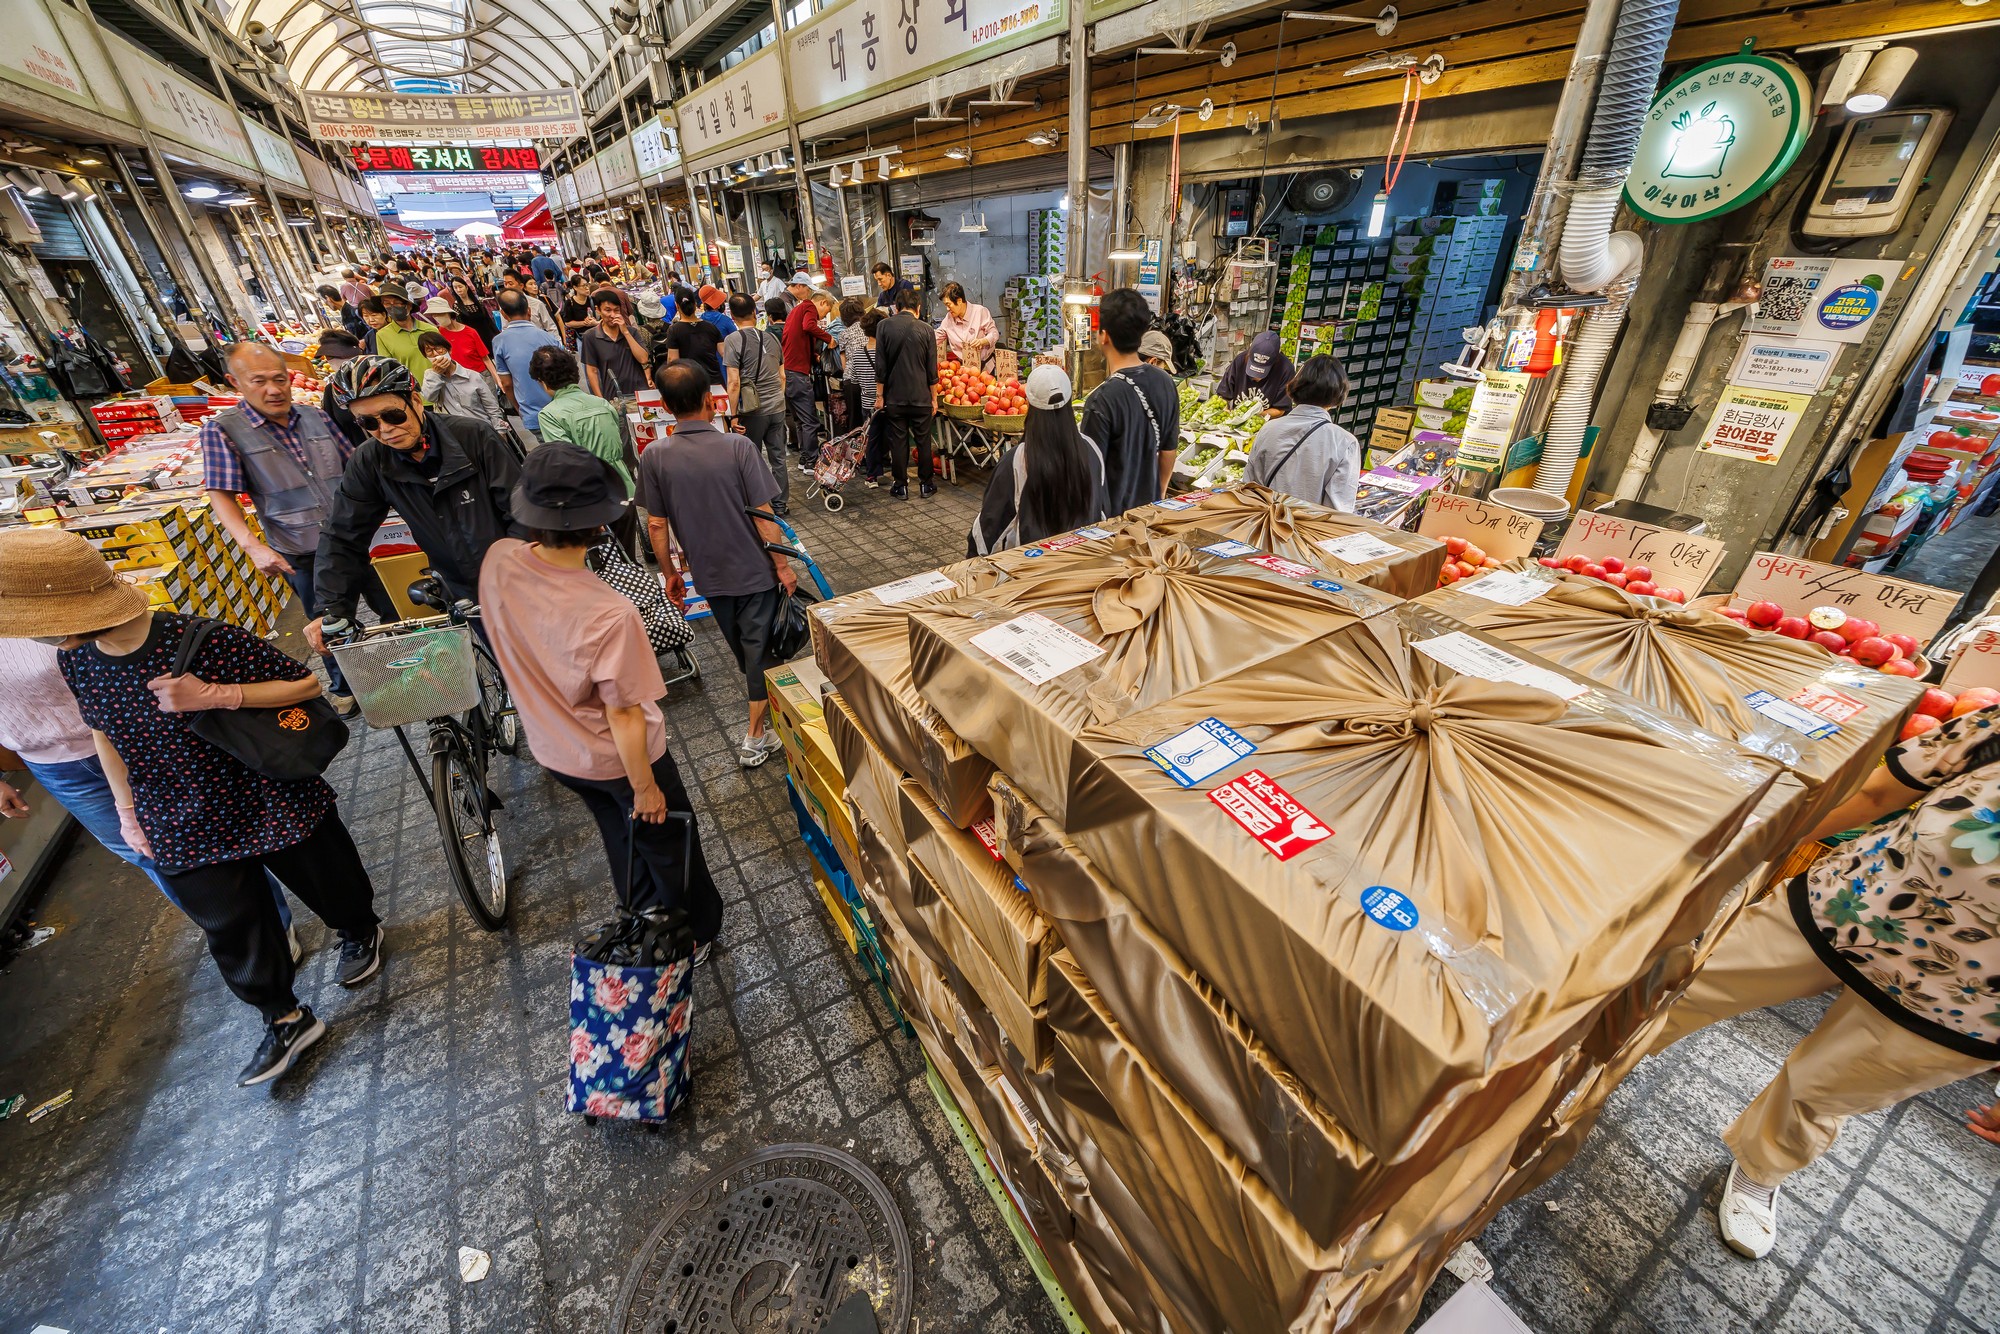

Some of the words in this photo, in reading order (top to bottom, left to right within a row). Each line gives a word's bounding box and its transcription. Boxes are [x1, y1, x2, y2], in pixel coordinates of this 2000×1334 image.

[696, 80, 756, 139] 대일청과
[1771, 259, 1795, 269] 온누리
[1822, 305, 1871, 316] 피해지원금
[1835, 297, 1866, 306] 고유가
[1722, 408, 1786, 431] 환급행사
[1715, 423, 1778, 447] 참여점포
[1201, 718, 1255, 755] 신선식품
[1243, 771, 1304, 820] 파손주의
[1369, 892, 1404, 920] 냉장보관
